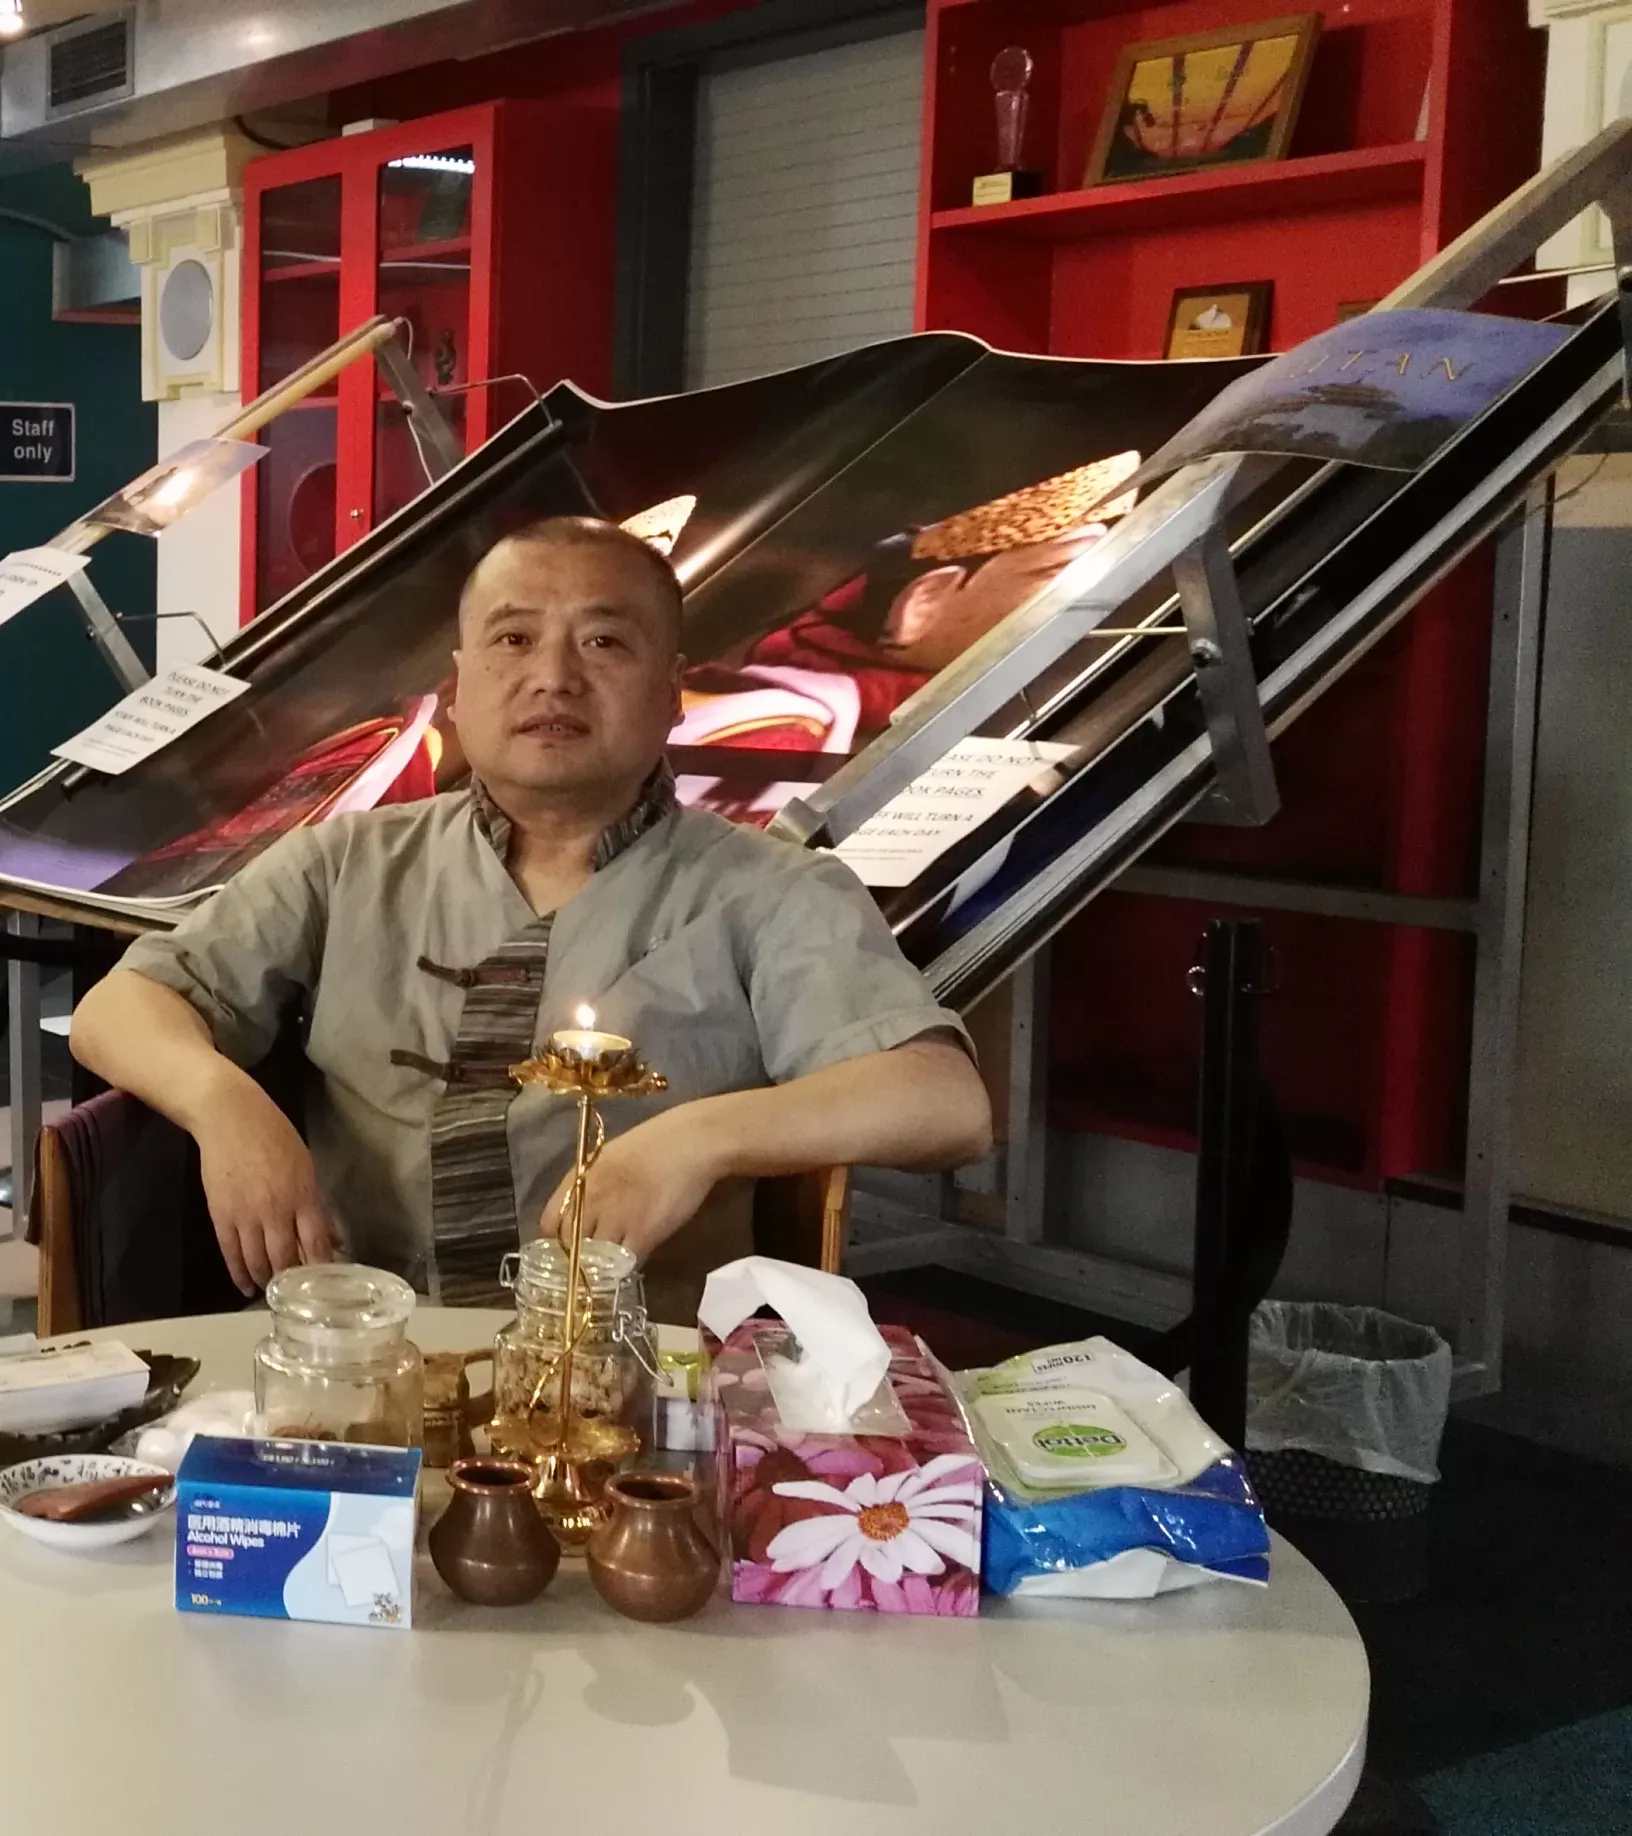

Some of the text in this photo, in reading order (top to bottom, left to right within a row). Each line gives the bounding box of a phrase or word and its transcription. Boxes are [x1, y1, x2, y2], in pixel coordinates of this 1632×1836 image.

[11, 418, 55, 437] Staff
[13, 443, 52, 464] only
[930, 768, 965, 779] URN
[926, 812, 962, 822] TURN
[1037, 1434, 1122, 1449] Dettol
[187, 1530, 265, 1550] Alcohol Wipes
